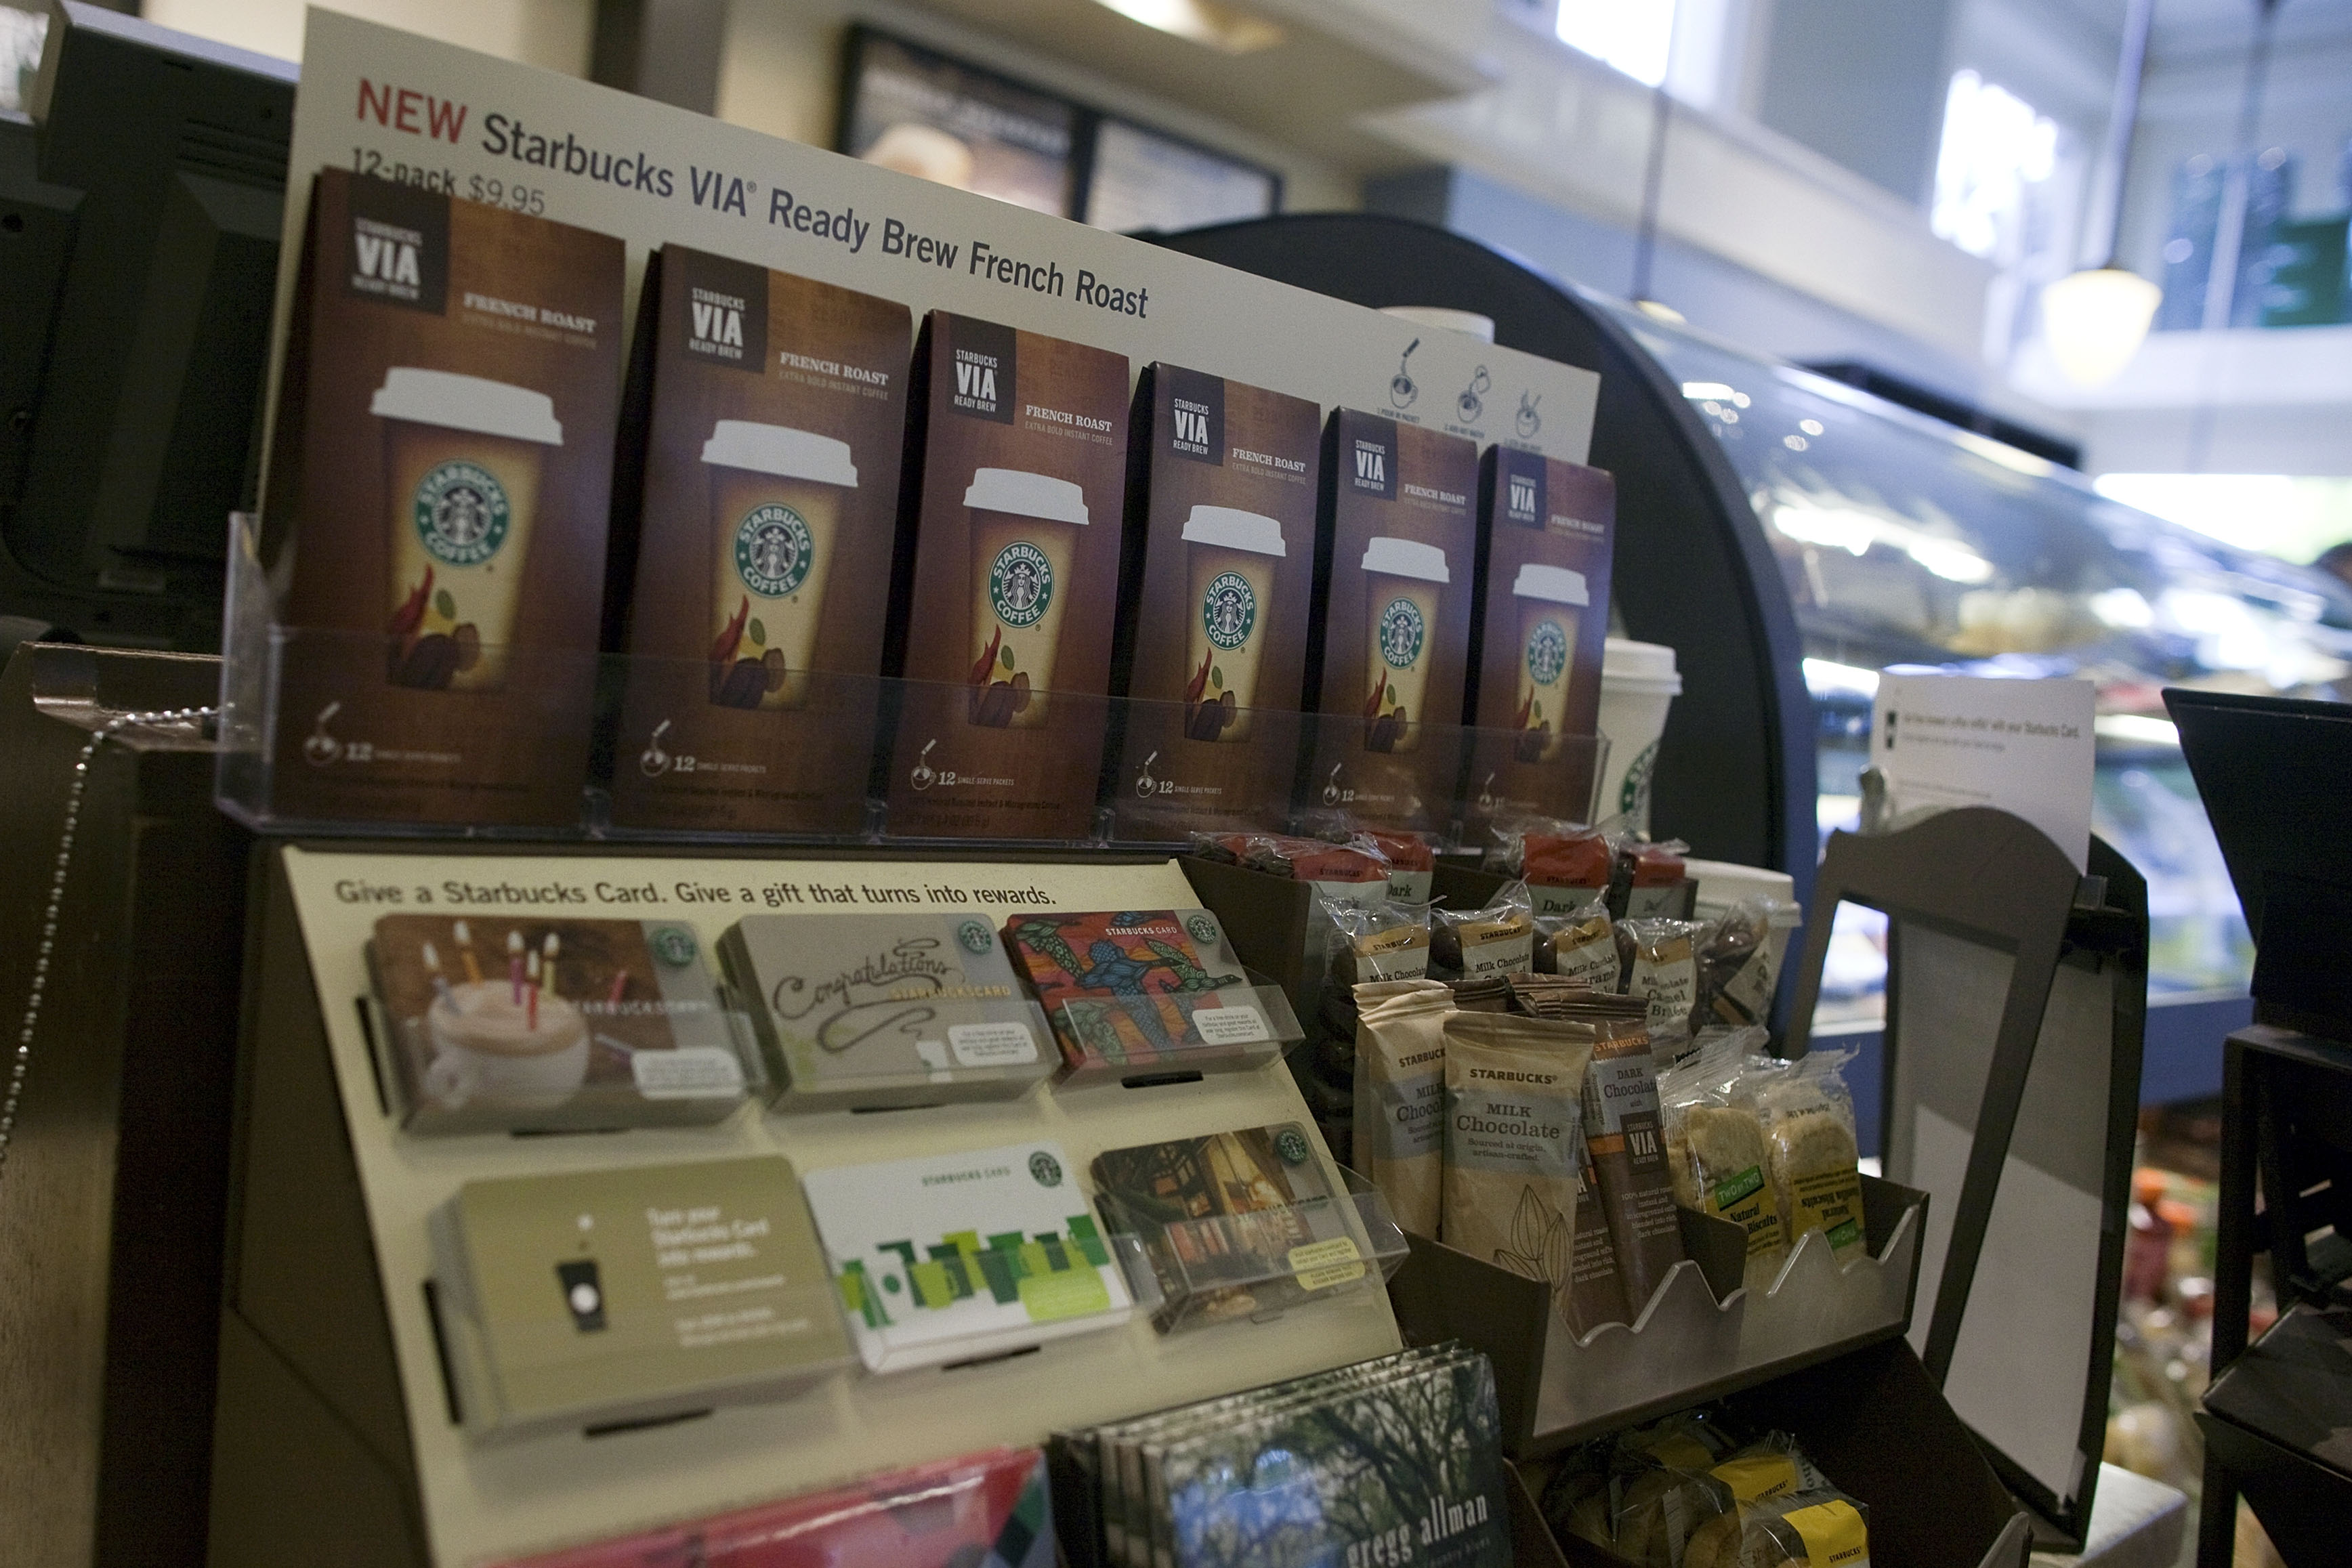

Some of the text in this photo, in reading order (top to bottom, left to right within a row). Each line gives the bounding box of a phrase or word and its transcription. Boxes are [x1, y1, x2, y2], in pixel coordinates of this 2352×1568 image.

[358, 78, 467, 144] NEW
[482, 112, 675, 197] Starbucks
[768, 188, 870, 253] Ready
[882, 218, 959, 269] Brew
[969, 241, 1064, 297] French
[1075, 269, 1148, 318] Roast
[354, 234, 421, 288] VIA
[692, 287, 745, 312] STARBUCKS
[465, 292, 537, 322] FRENCH
[542, 310, 596, 333] ROAST
[692, 301, 743, 347] VIA
[956, 349, 998, 368] STARBUCKS
[780, 352, 889, 386] FRENCH ROAST
[956, 362, 996, 401] VIA
[954, 396, 996, 412] READY BREW
[1175, 398, 1209, 415] STARBUCKS
[1026, 404, 1112, 432] FRENCH ROAST
[1175, 409, 1209, 445] VIA
[1025, 421, 1112, 446] EXTRA BOLD INSTANT COFFEE
[1173, 440, 1209, 455] READY BREW
[1356, 440, 1385, 454] STARBUCKS
[1233, 448, 1305, 472] FRENCH ROAST
[1356, 450, 1385, 482] VIA
[1355, 478, 1385, 491] READY BREW
[1404, 483, 1466, 505] FRENCH ROAST
[1510, 484, 1535, 513] VIA
[739, 508, 811, 551] STARBUCKS
[994, 546, 1050, 584] STARBUCKS
[744, 566, 797, 593] COFFEE
[1206, 576, 1253, 610] STARBUCKS
[997, 600, 1040, 623] COFFEE
[1382, 601, 1422, 633] STARBUCKS
[1209, 624, 1245, 646] COFFEE
[1383, 647, 1415, 666] COFFEE
[674, 755, 696, 773] 12
[938, 771, 956, 786] 12
[1159, 781, 1173, 794] 12
[1341, 790, 1354, 802] 12
[335, 881, 1057, 908] Give a Starbucks Card. Give a gift that turns into rewards.
[1542, 899, 1576, 912] Dark
[1106, 927, 1154, 935] STARBUCKS
[1480, 927, 1521, 940] STARBUCKS
[1475, 960, 1495, 973] Milk
[1497, 954, 1530, 969] Chocolate
[1569, 965, 1587, 976] Milk
[1595, 1036, 1649, 1051] STARBUCKS
[1399, 1047, 1446, 1067] STARBUCK
[1617, 1067, 1643, 1080] DARK
[1397, 1098, 1445, 1122] Chocol
[1487, 1103, 1532, 1118] MILK
[1456, 1115, 1559, 1139] Chocolate
[1627, 1121, 1653, 1132] STARBUCKS
[1468, 1138, 1503, 1149] Sourced
[1505, 1140, 1514, 1149] at
[1629, 1130, 1658, 1156] VIA
[922, 1170, 982, 1187] STARBUCKS
[1719, 1174, 1760, 1202] TWO TWO
[1621, 1192, 1638, 1201] 100%
[1730, 1203, 1760, 1223] Natural
[1631, 1219, 1654, 1229] blended
[1637, 1229, 1652, 1238] dark
[1748, 1214, 1778, 1235] Biscuits
[1347, 1523, 1413, 1568] gregg
[1421, 1494, 1488, 1546] allman
[1829, 1546, 1862, 1563] STARBUCKS
